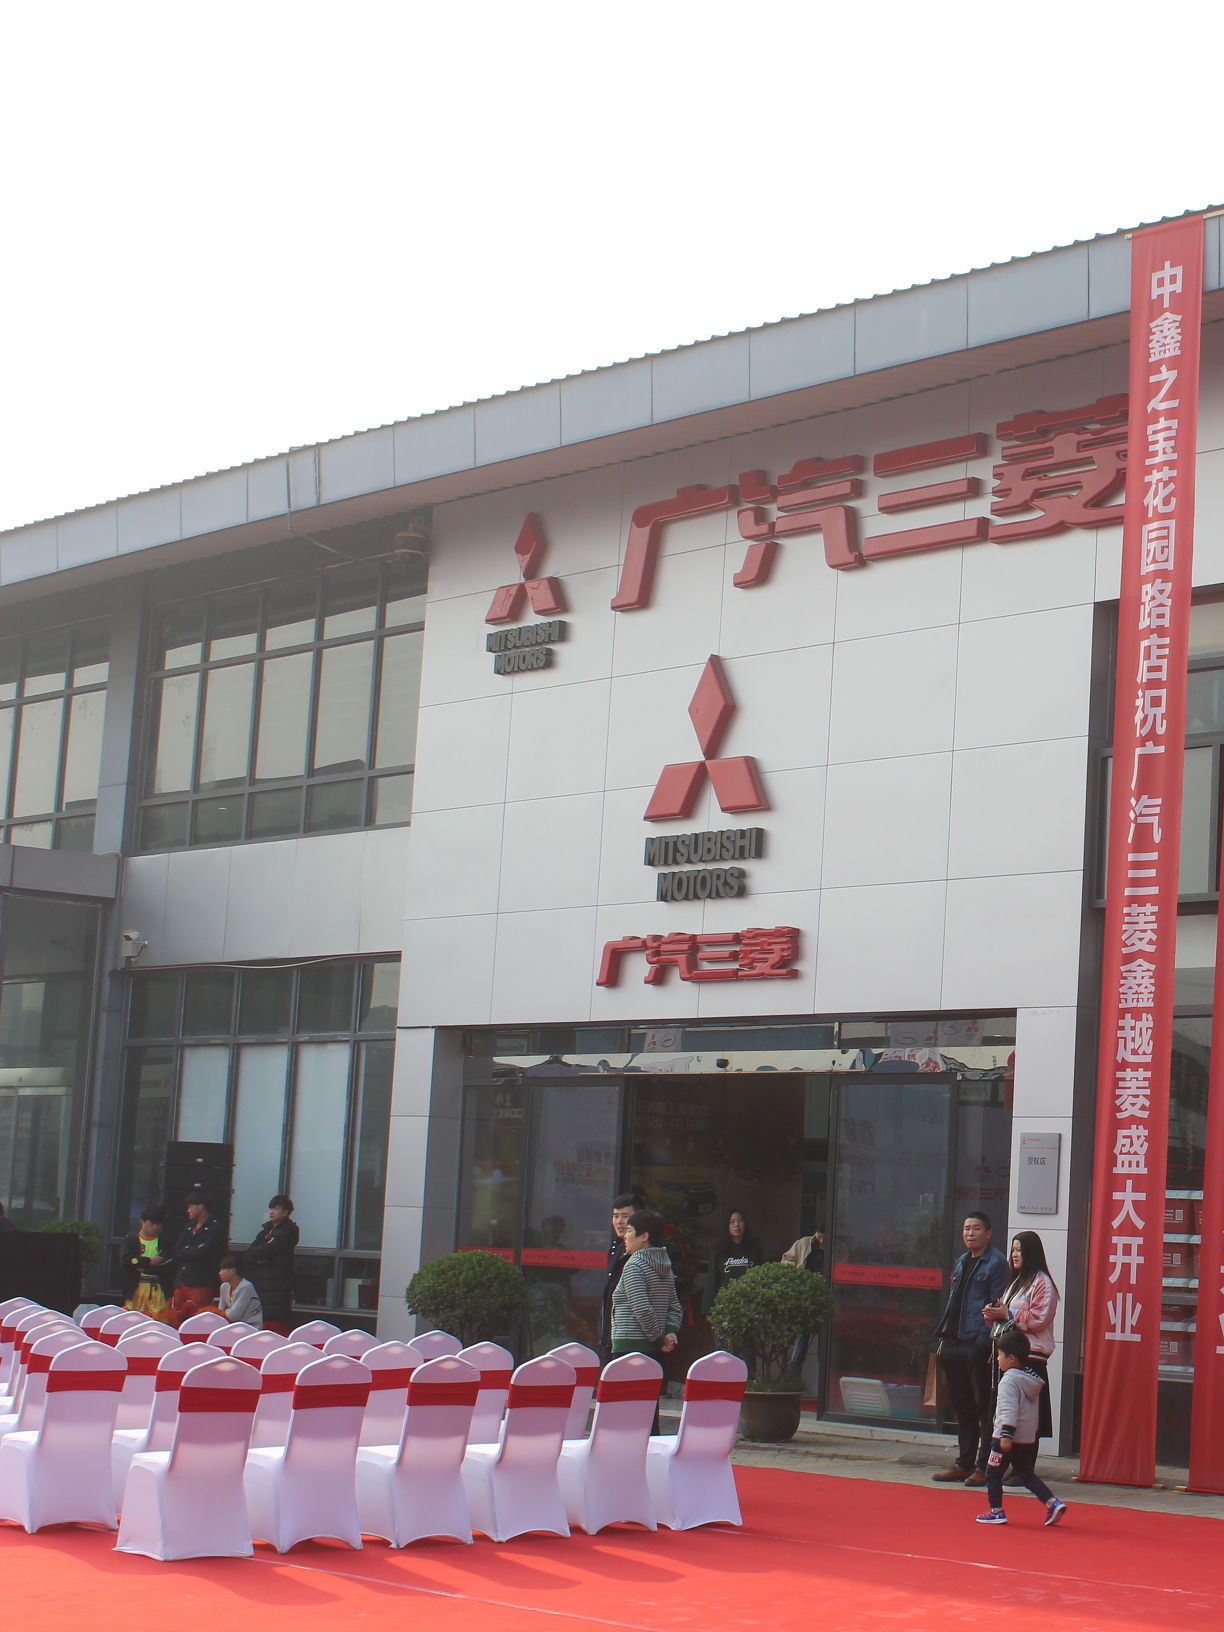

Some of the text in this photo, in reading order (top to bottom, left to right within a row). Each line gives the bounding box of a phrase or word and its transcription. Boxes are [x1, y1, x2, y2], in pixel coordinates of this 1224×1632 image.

[611, 393, 1130, 612] 广汽三菱
[486, 620, 567, 653] MITSUBISHI
[494, 647, 553, 675] MOTORS
[1104, 259, 1185, 1342] 中鑫之宝花园路店祝广汽三菱鑫越菱盛大开业
[644, 827, 764, 866] MITSUBISHI
[656, 866, 746, 901] MOTORS
[596, 926, 800, 987] 广汽三菱
